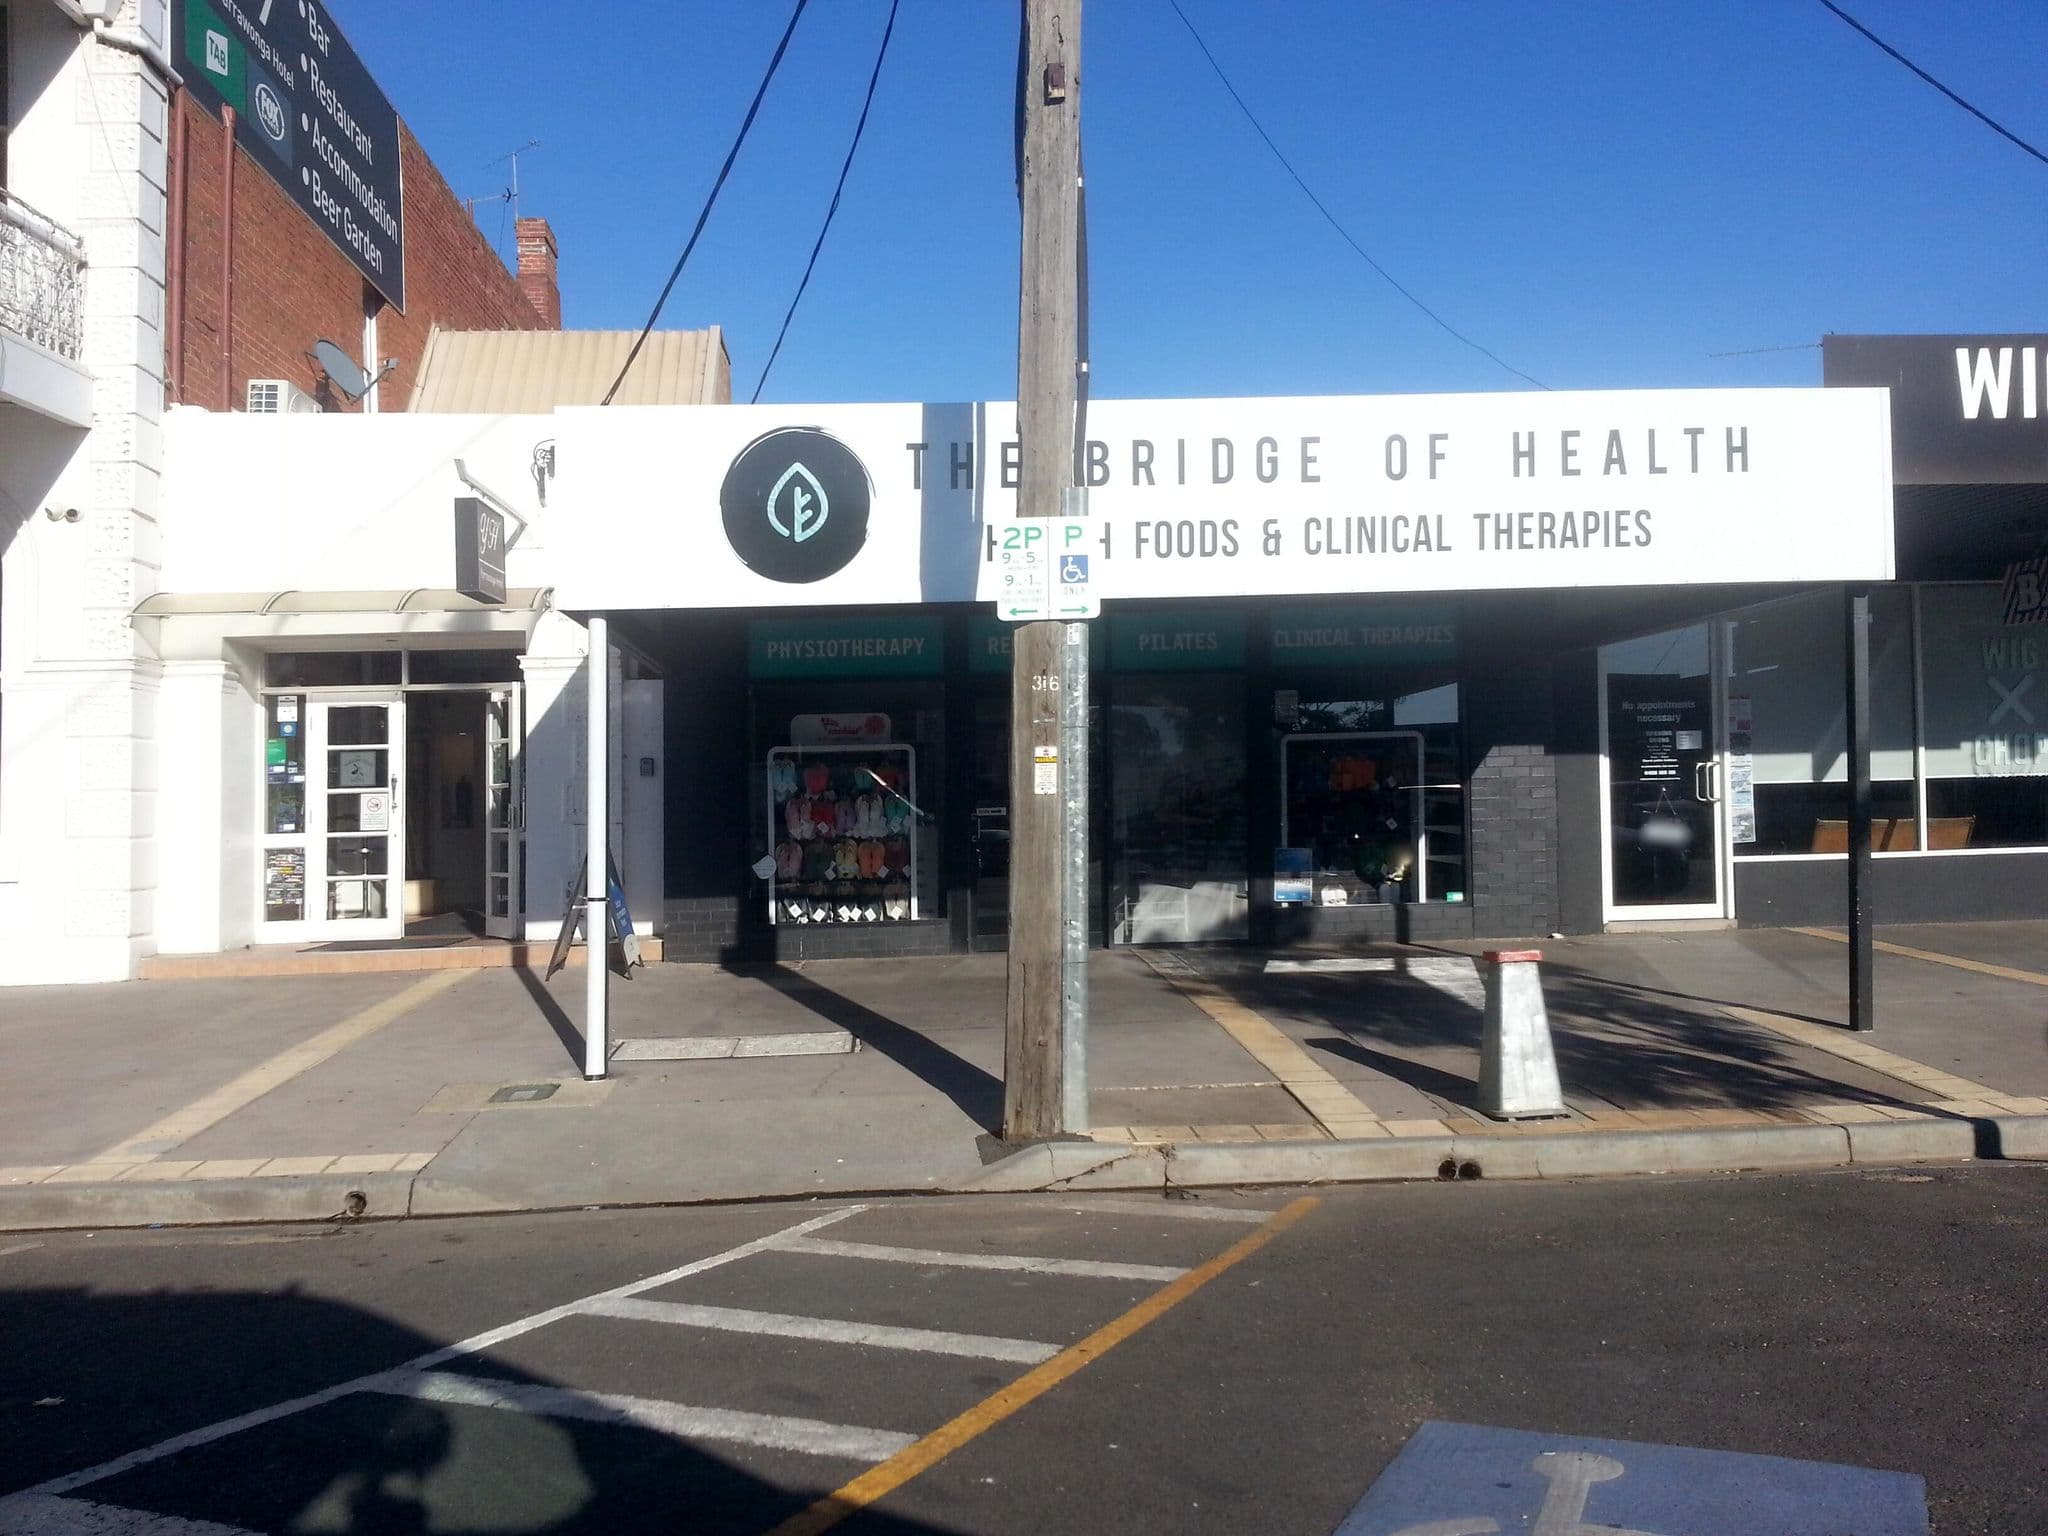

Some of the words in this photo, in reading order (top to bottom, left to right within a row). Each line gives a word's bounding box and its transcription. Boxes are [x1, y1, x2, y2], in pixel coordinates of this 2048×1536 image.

[308, 2, 330, 58] Bar
[208, 36, 226, 69] TAB
[272, 48, 294, 91] Hotel
[261, 89, 279, 125] FOX
[310, 57, 373, 167] Restaurant
[312, 117, 399, 245] Accommodation
[312, 170, 342, 230] Beer
[343, 205, 384, 275] Garden
[1955, 347, 2048, 419] WI
[906, 442, 1021, 490] THE
[1086, 436, 1321, 487] BRIDGE
[1385, 433, 1449, 481] OF
[1512, 426, 1748, 477] HEALTH
[1003, 527, 1042, 549] 2P
[1065, 525, 1083, 548] P
[1135, 520, 1240, 559] FOODS
[1263, 518, 1282, 556] &
[1304, 514, 1452, 555] CLINICAL
[1473, 510, 1652, 551] THERAPIES
[766, 637, 927, 659] PHYSIOTHERAPY
[1138, 632, 1218, 651] PILATES
[1273, 628, 1353, 648] CLINICAL
[1359, 625, 1456, 645] THERAPIES
[1032, 675, 1060, 691] 316
[1636, 714, 1681, 723] necessary
[1637, 700, 1696, 712] appointments
